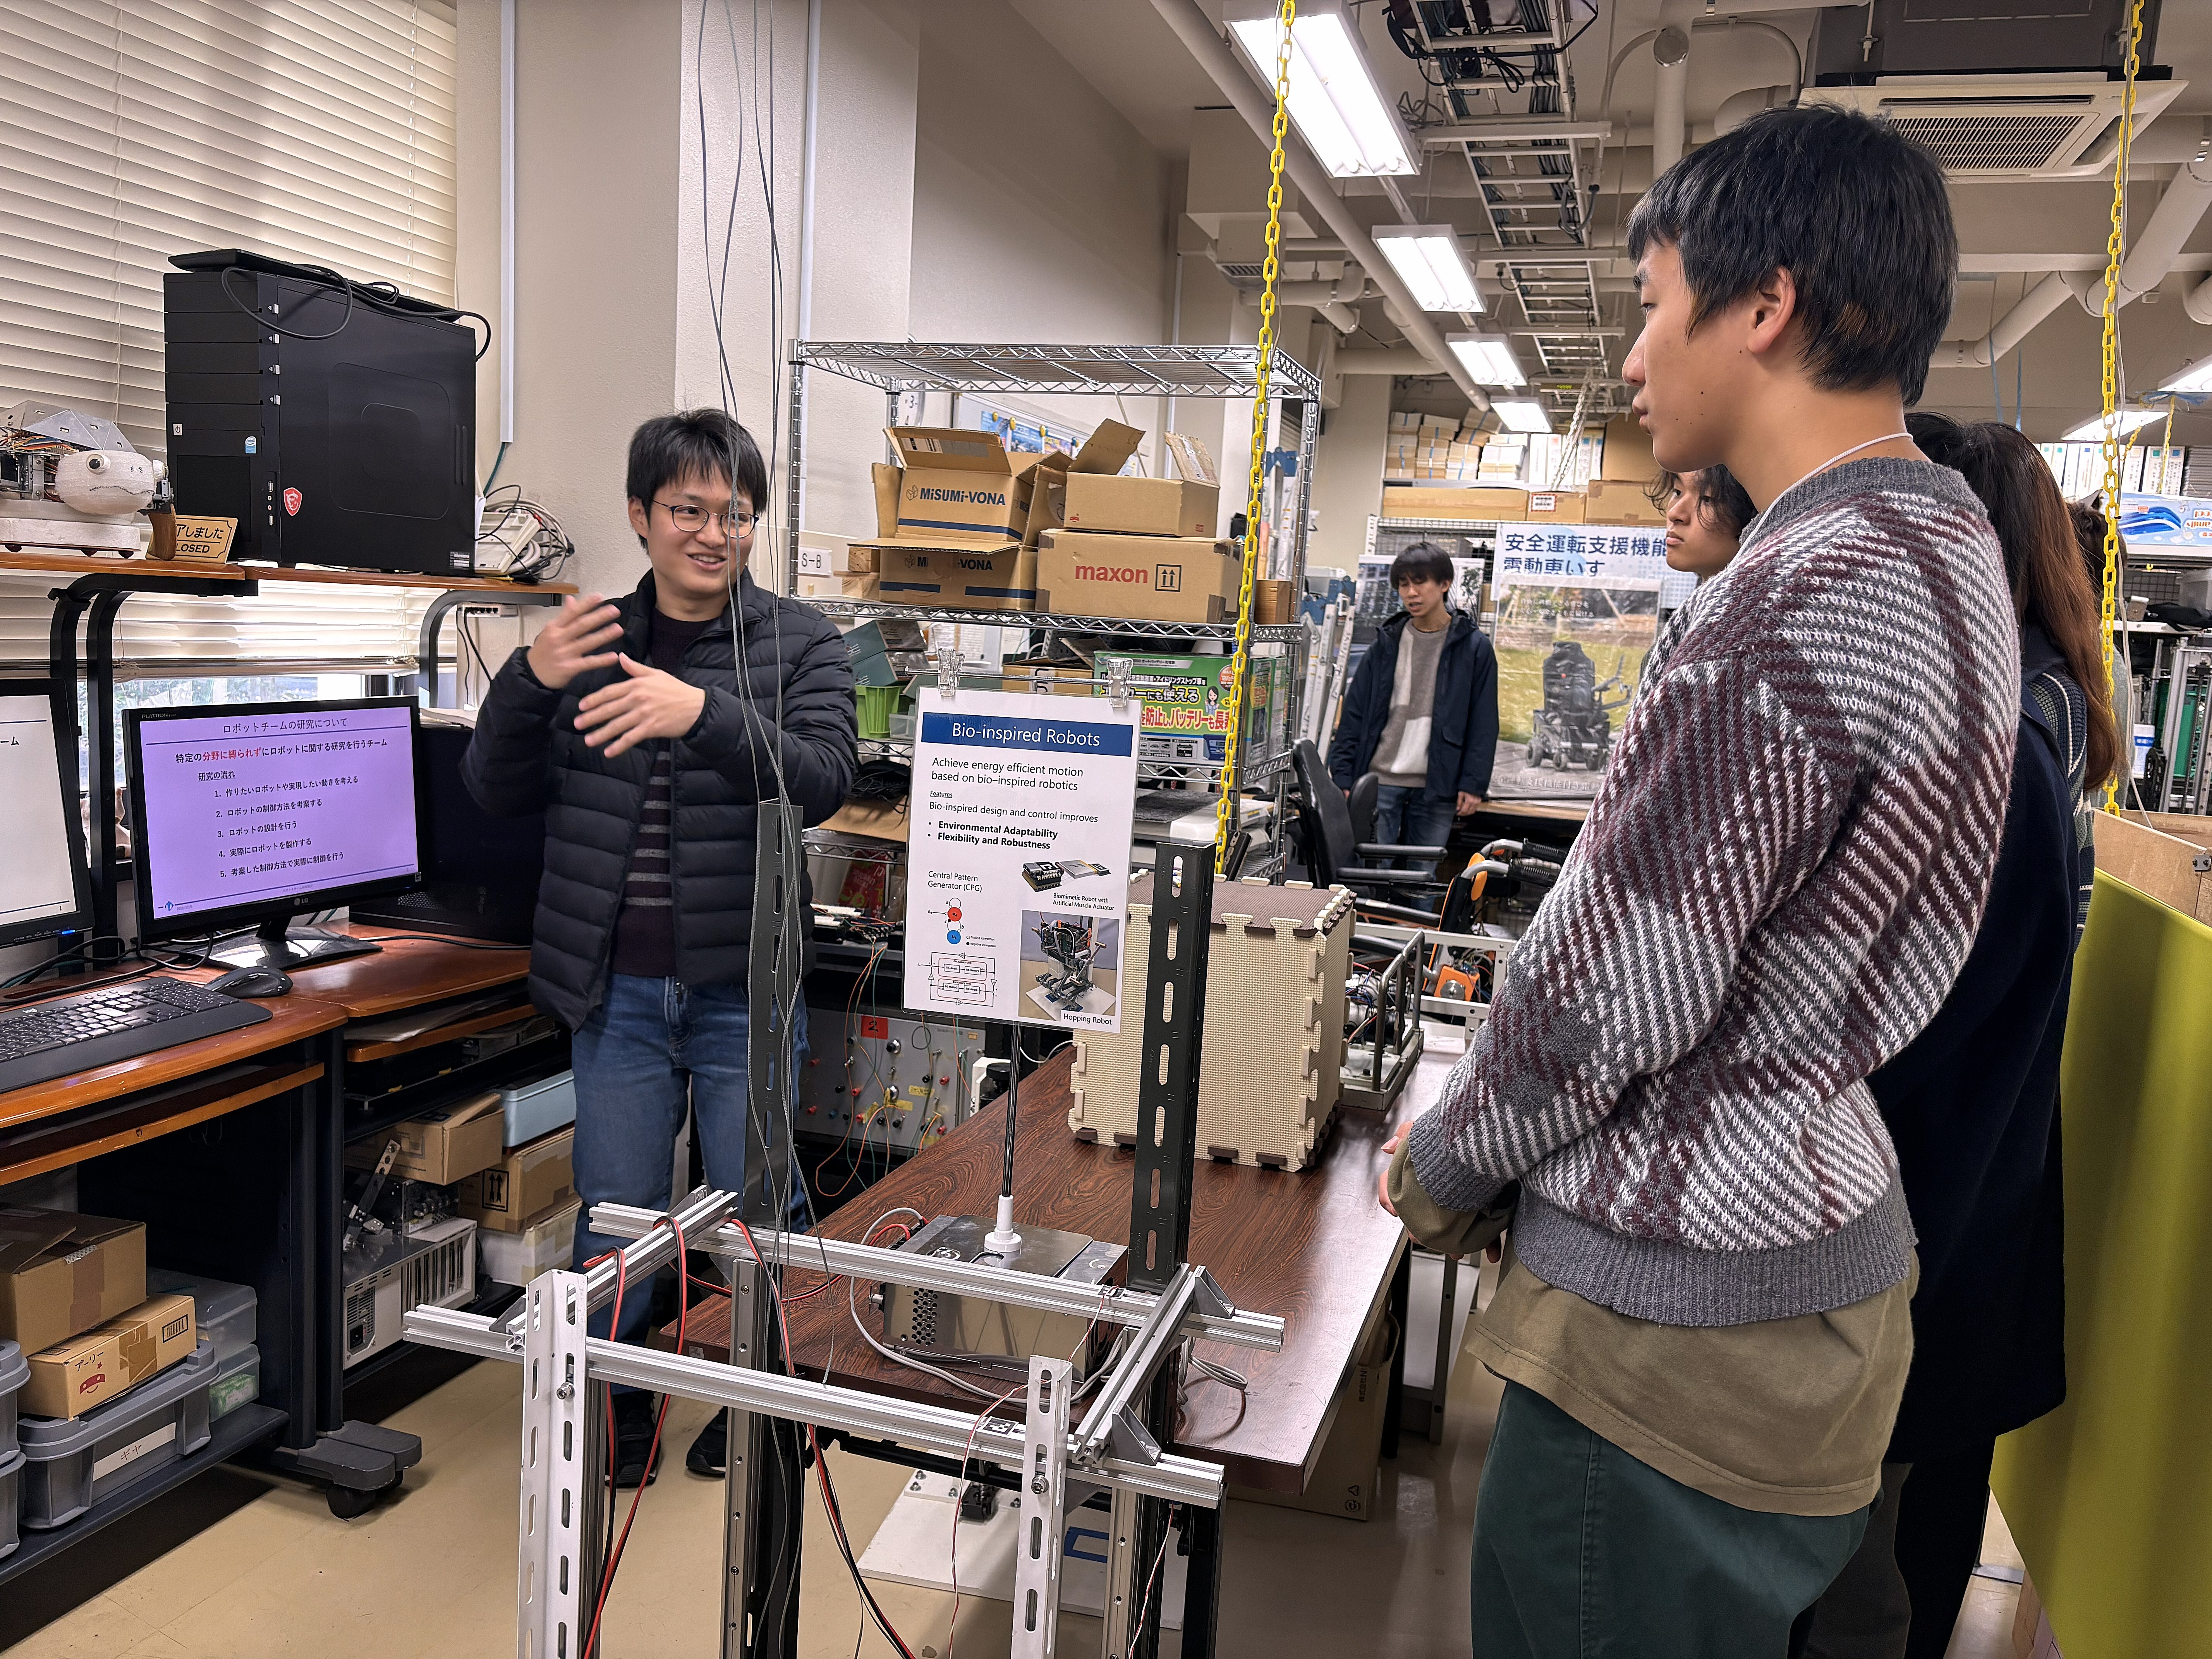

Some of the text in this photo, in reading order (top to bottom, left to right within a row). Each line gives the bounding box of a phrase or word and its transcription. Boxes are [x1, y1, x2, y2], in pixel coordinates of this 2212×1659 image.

[176, 543, 210, 553] LOSED
[1075, 565, 1148, 584] maxon
[223, 718, 348, 733] ロボットチームの研究について
[953, 723, 1100, 746] Bio-inspired Robots
[932, 757, 1083, 777] Achieve energy efficient motion
[198, 770, 235, 782] 研究の流れ
[932, 771, 959, 781] based
[1039, 780, 1078, 791] robotics
[930, 802, 978, 814] Bio-inspired
[981, 806, 1007, 817] design
[1028, 810, 1057, 819] control
[1060, 812, 1098, 823] improves
[939, 821, 1058, 840] Environmental Adaptability
[938, 833, 980, 845] Flexibility
[1001, 839, 1050, 850] Robustness
[928, 871, 978, 882] Central Pattern
[928, 881, 982, 893] Generator (CPG)
[868, 1020, 878, 1032] 2
[1063, 1013, 1112, 1025] Hopping Robot
